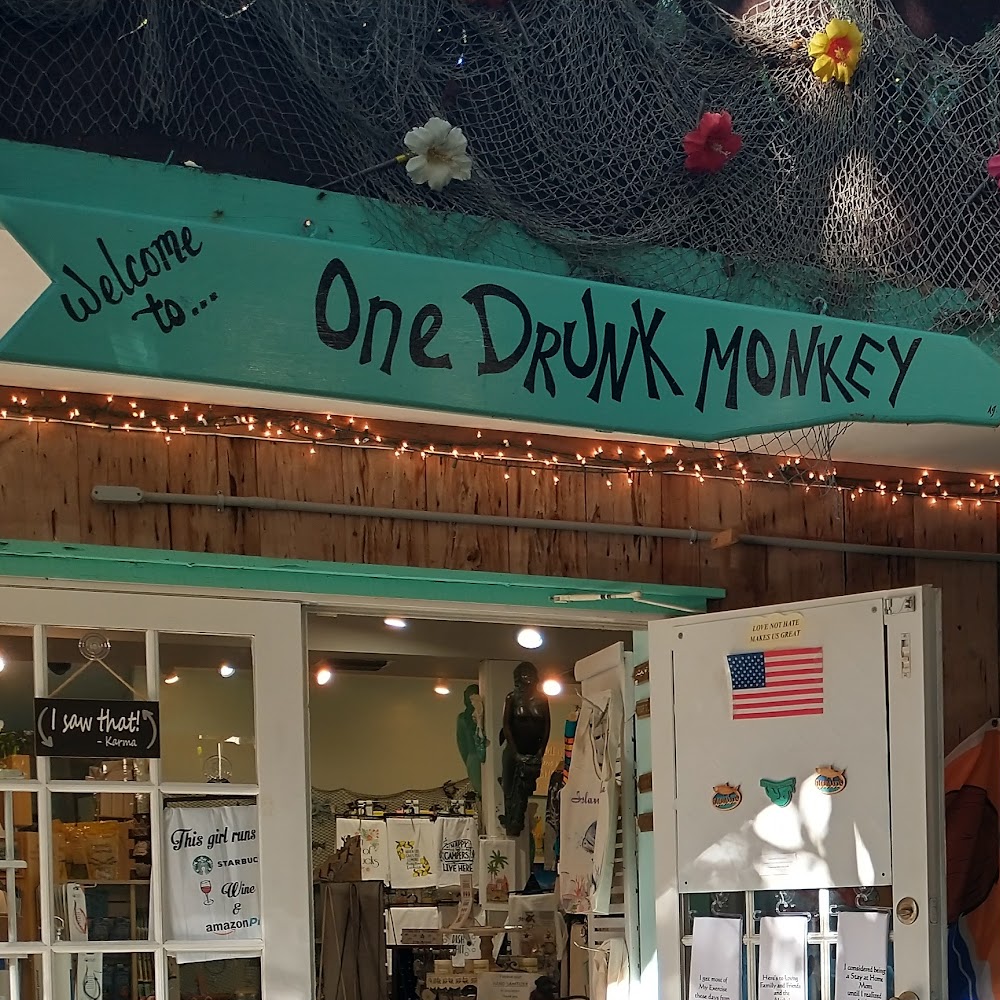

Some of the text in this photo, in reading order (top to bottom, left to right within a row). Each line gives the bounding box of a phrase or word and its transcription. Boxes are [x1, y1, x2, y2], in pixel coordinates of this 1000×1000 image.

[60, 226, 202, 322] Welcome
[131, 291, 218, 334] to...
[316, 258, 922, 414] One DRUNK MONKEY
[752, 624, 768, 632] LOVE
[783, 619, 800, 628] HATE
[750, 634, 770, 642] MAKES
[780, 630, 800, 638] GREAT
[51, 708, 140, 733] I saw that!
[106, 736, 138, 746] Karma
[571, 790, 600, 804] Islan
[170, 826, 256, 851] This girl runs
[218, 856, 258, 868] STARBUC
[442, 863, 474, 872] LIVE HERE
[221, 881, 256, 898] Wine
[232, 902, 242, 915] &
[850, 972, 863, 981] Stay
[874, 966, 886, 976] being
[710, 984, 728, 992] Exercise
